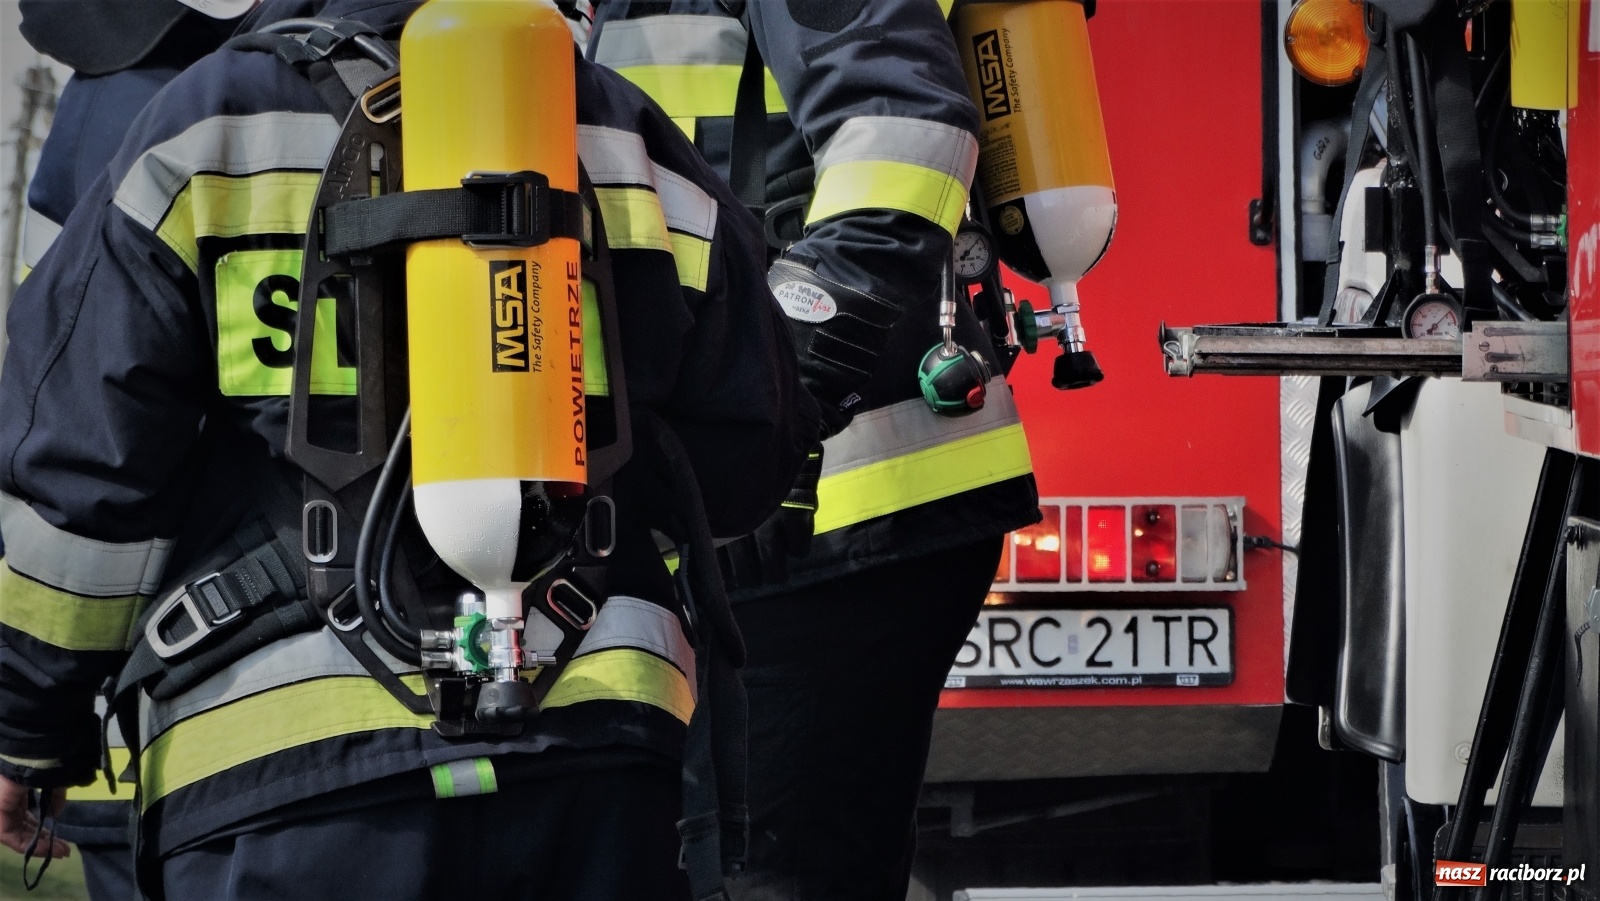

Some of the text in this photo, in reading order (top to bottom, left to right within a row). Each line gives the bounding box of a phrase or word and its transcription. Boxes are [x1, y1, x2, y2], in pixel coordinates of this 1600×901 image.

[977, 34, 1008, 114] MSA
[1001, 28, 1021, 113] The Safety Company
[495, 265, 525, 367] MSA
[531, 261, 543, 372] The Safety Company
[778, 290, 814, 306] PATRON
[566, 261, 585, 466] POWIETRZE
[1000, 675, 1143, 687] www.wawrzaszek.com.pl
[1085, 615, 1218, 668] 21TR
